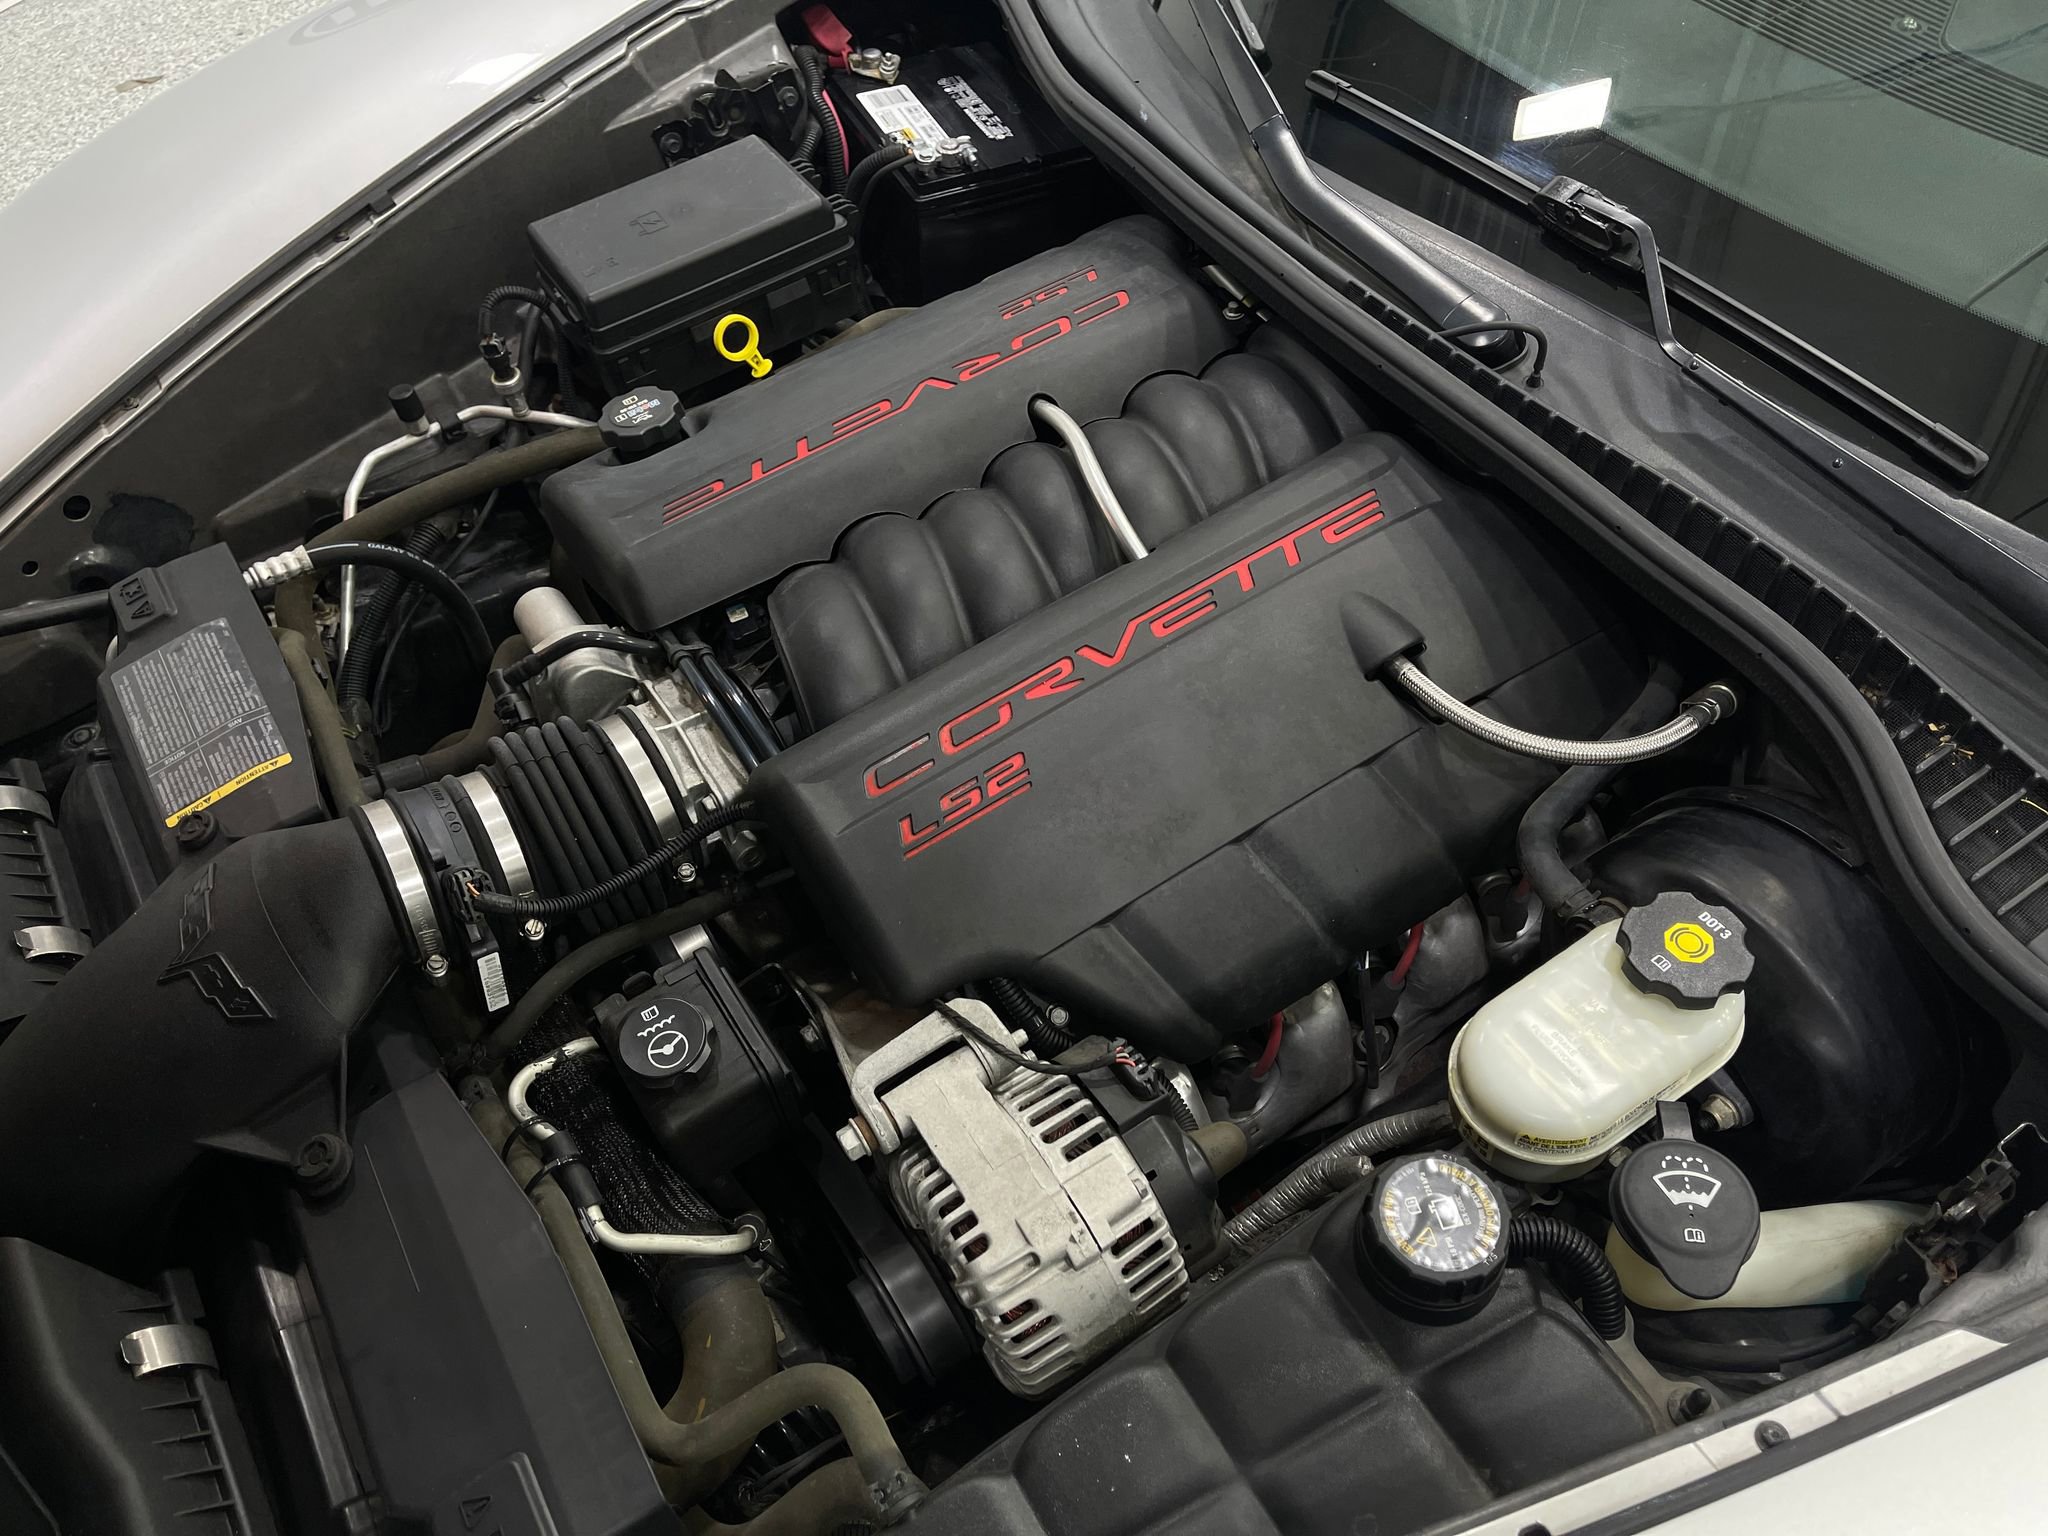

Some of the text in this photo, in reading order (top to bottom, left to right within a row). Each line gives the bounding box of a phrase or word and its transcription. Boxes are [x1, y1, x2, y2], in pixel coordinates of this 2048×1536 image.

[1001, 267, 1098, 321] LS2
[662, 289, 1130, 526] CORVETTE
[368, 543, 405, 554] GALAXY
[862, 487, 1385, 798] CORVETTE
[227, 717, 242, 728] AVIS
[164, 750, 186, 765] NOTICE
[235, 763, 270, 786] ATTENTION
[176, 800, 204, 820] CAUTION
[899, 751, 1031, 850] LS2
[1698, 911, 1732, 939] DOT 3
[1533, 1136, 1588, 1145] AVERTISSEMENT
[1534, 1146, 1574, 1154] CONTENANT
[1483, 1252, 1498, 1266] TVS
